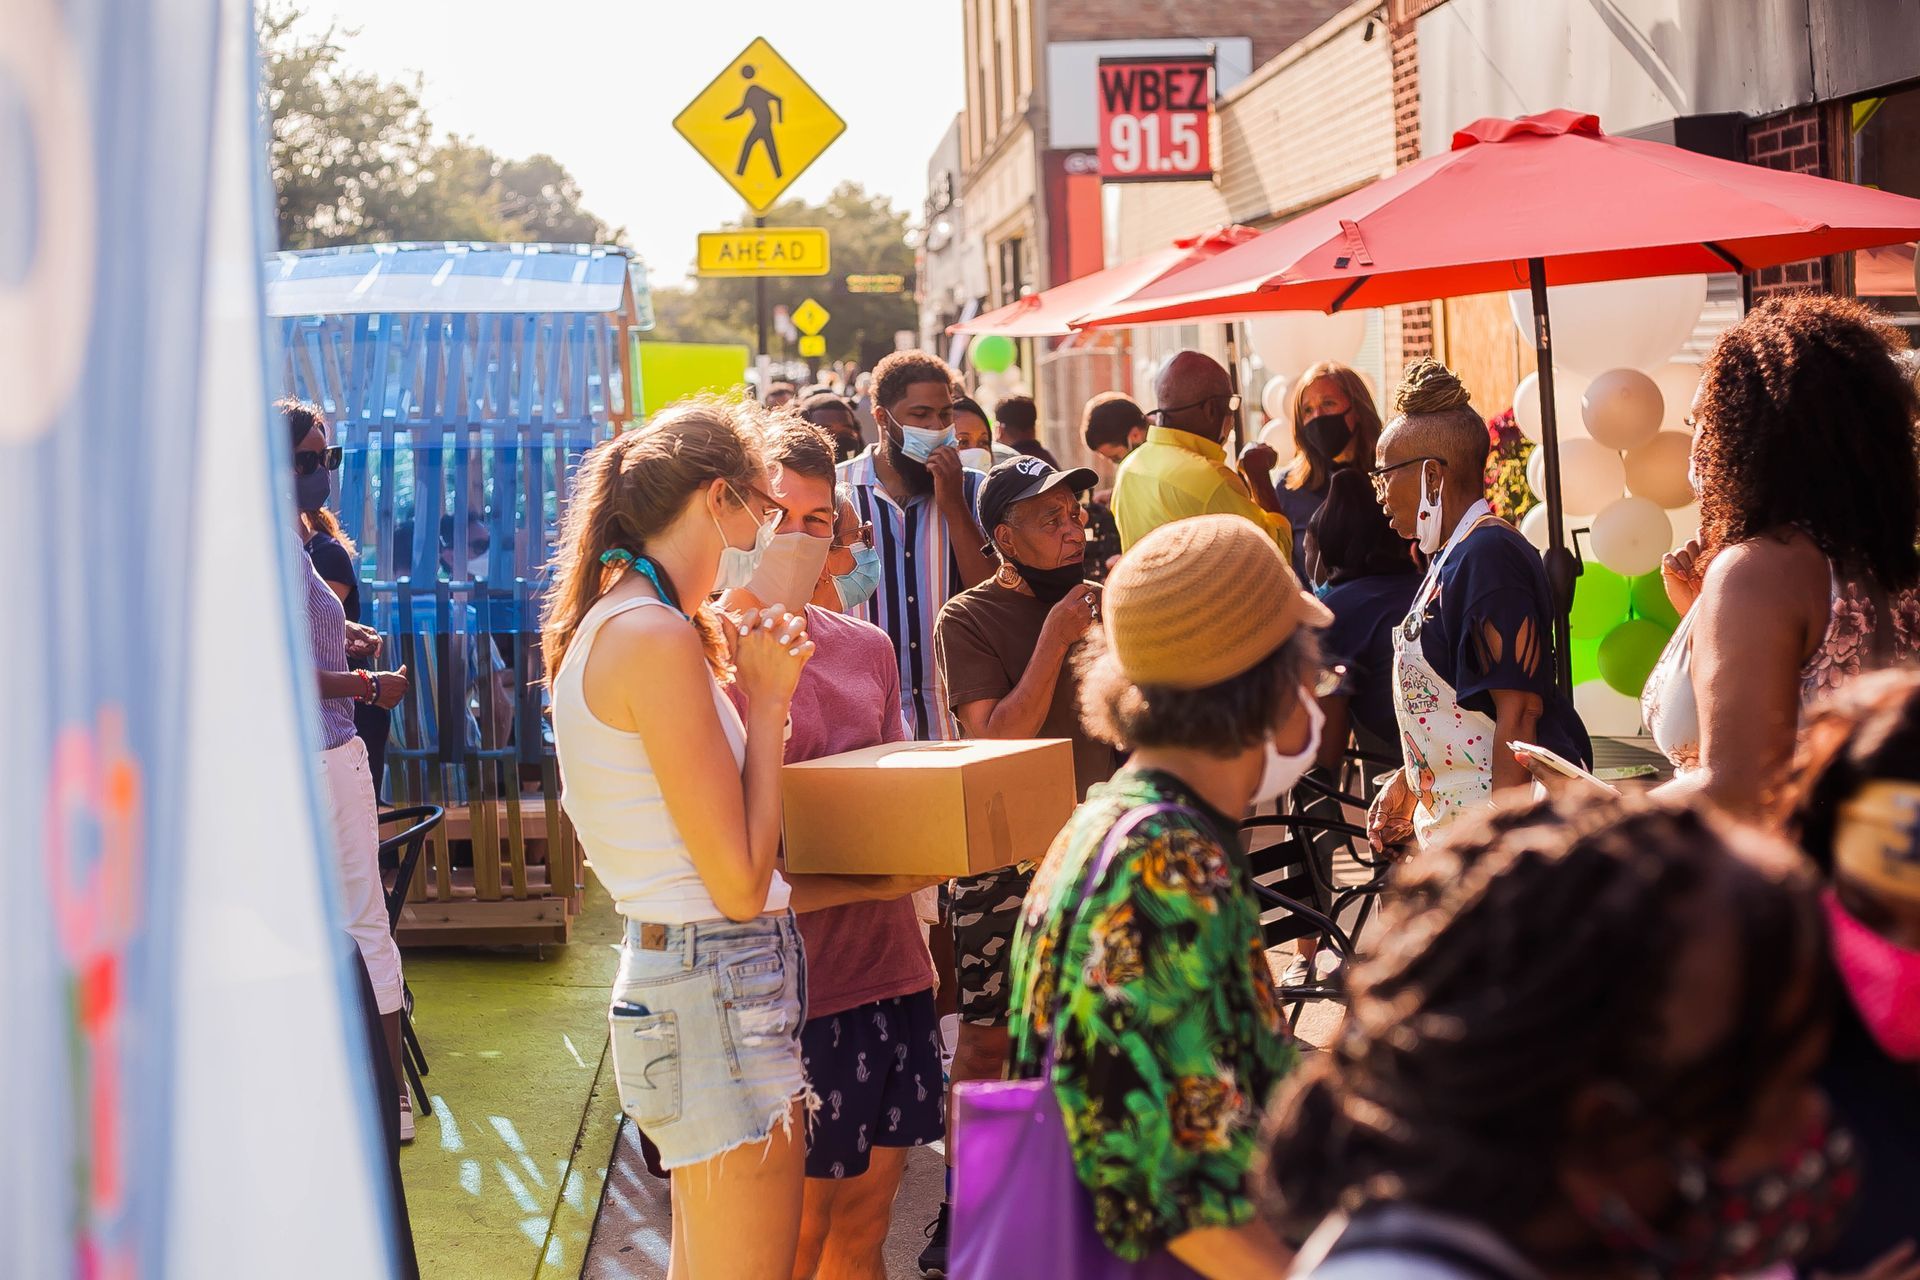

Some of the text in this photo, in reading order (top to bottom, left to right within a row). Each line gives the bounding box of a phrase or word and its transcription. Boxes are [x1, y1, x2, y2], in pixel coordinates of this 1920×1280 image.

[1101, 69, 1207, 113] WBEZ
[1110, 112, 1201, 173] 91.5
[718, 240, 805, 262] AHEAD
